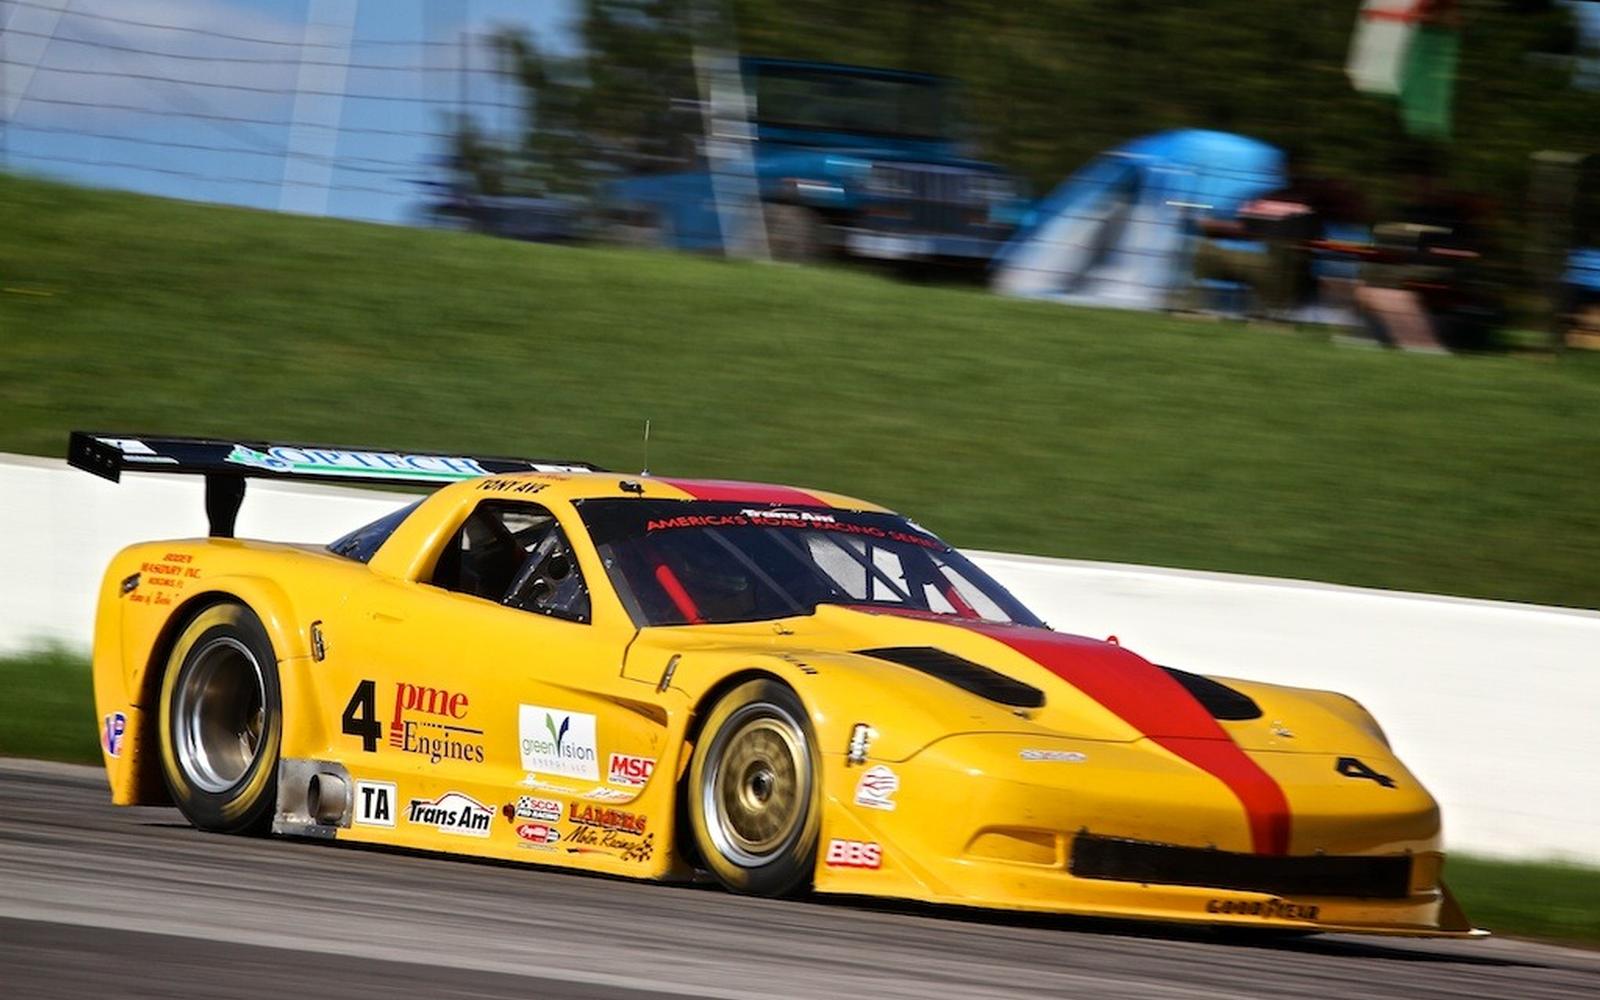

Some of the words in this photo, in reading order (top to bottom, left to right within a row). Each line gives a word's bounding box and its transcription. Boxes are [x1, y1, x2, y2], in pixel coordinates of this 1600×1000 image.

[270, 447, 487, 474] OPTECH
[477, 479, 521, 491] TONY
[513, 482, 550, 493] AVE
[647, 516, 748, 531] AMERICA'S
[751, 516, 807, 529] ROAD
[812, 522, 885, 538] RACING
[740, 509, 797, 520] Trans
[799, 511, 836, 523] Am
[342, 679, 382, 752] 4
[390, 682, 470, 732] pme
[401, 720, 484, 764] Engines
[1334, 756, 1397, 789] 4
[362, 786, 390, 821] TA
[408, 800, 457, 827] Trans
[458, 805, 490, 830] Am
[530, 799, 560, 811] SCCA
[569, 801, 647, 835] LAMERS
[563, 826, 598, 845] Motor
[826, 839, 882, 869] BBS
[1205, 898, 1320, 920] GOODYEAR
